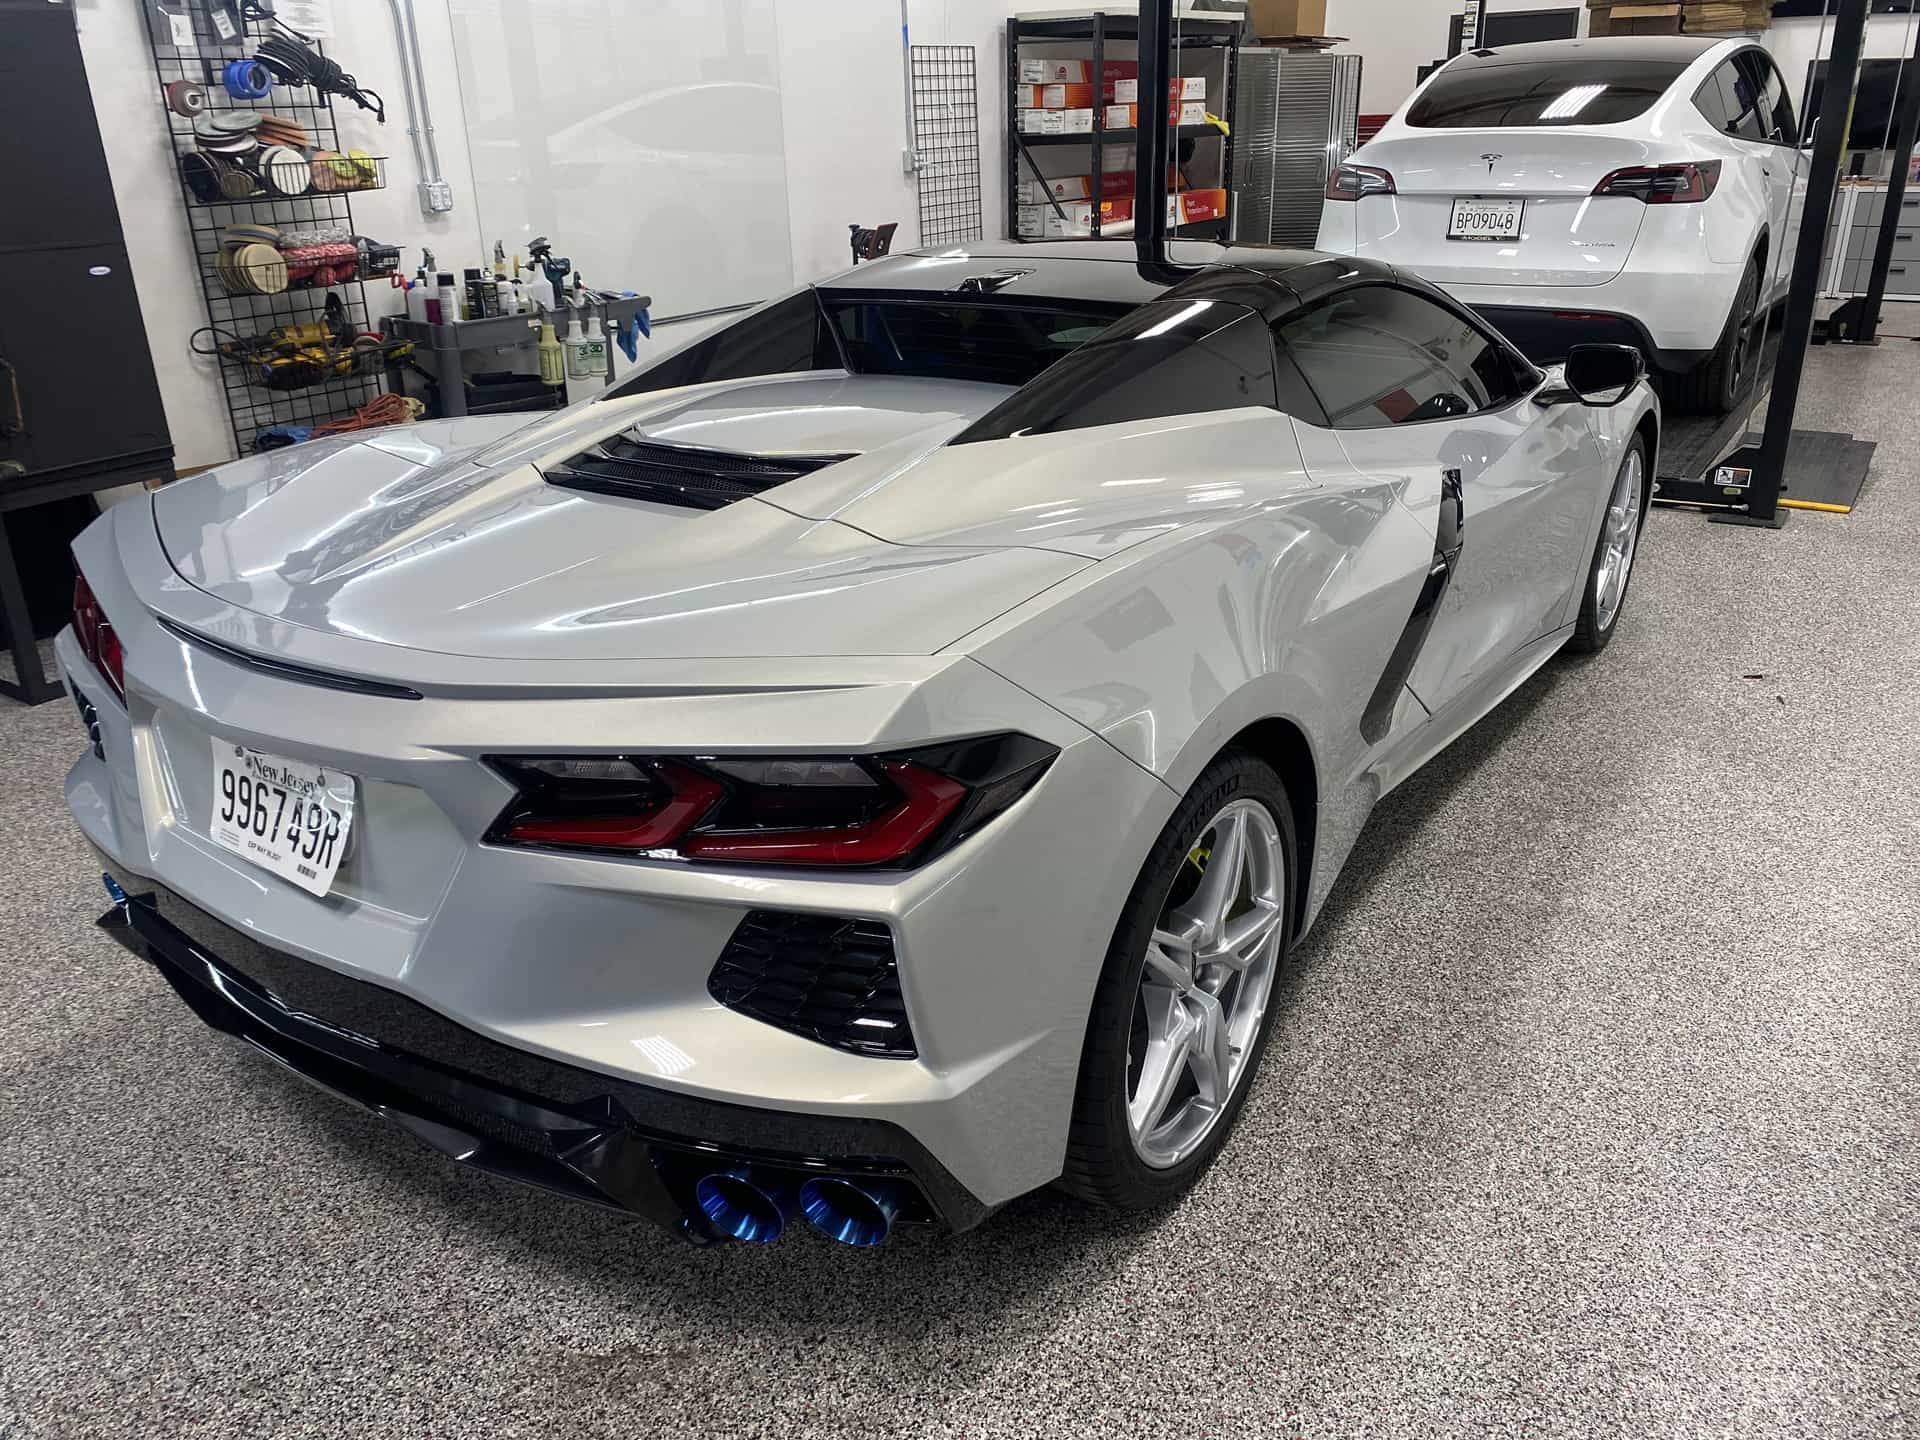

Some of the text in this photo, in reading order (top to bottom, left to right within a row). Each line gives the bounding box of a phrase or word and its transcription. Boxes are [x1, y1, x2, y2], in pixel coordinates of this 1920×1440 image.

[1456, 212, 1514, 230] BP09D48
[590, 344, 603, 353] 3D
[251, 757, 279, 780] New
[279, 767, 317, 797] Jersey
[221, 768, 341, 869] 996749R
